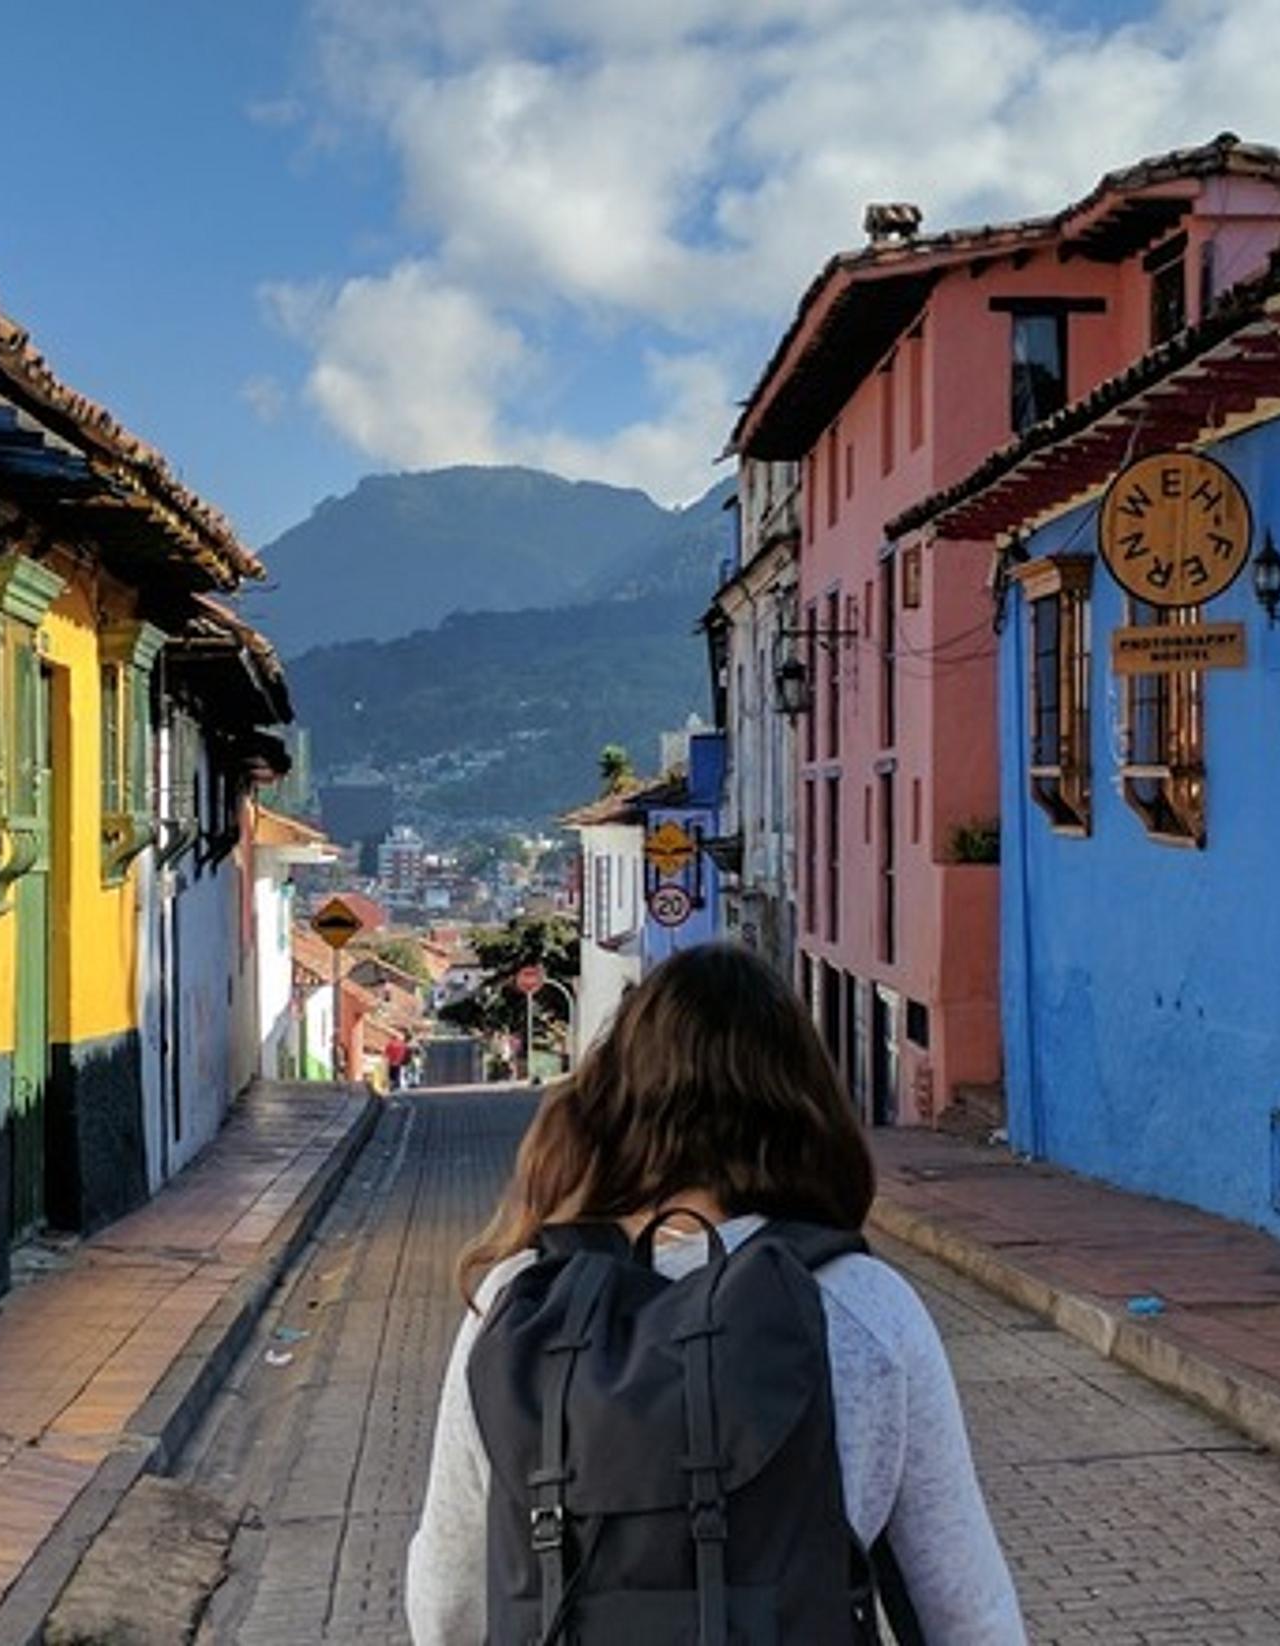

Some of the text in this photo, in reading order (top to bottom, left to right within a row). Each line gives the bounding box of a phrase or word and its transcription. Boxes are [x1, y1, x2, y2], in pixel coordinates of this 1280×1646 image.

[1120, 634, 1237, 649] PHOTOGRAPHY
[1151, 650, 1209, 662] HOSTEL
[658, 896, 682, 916] 20
